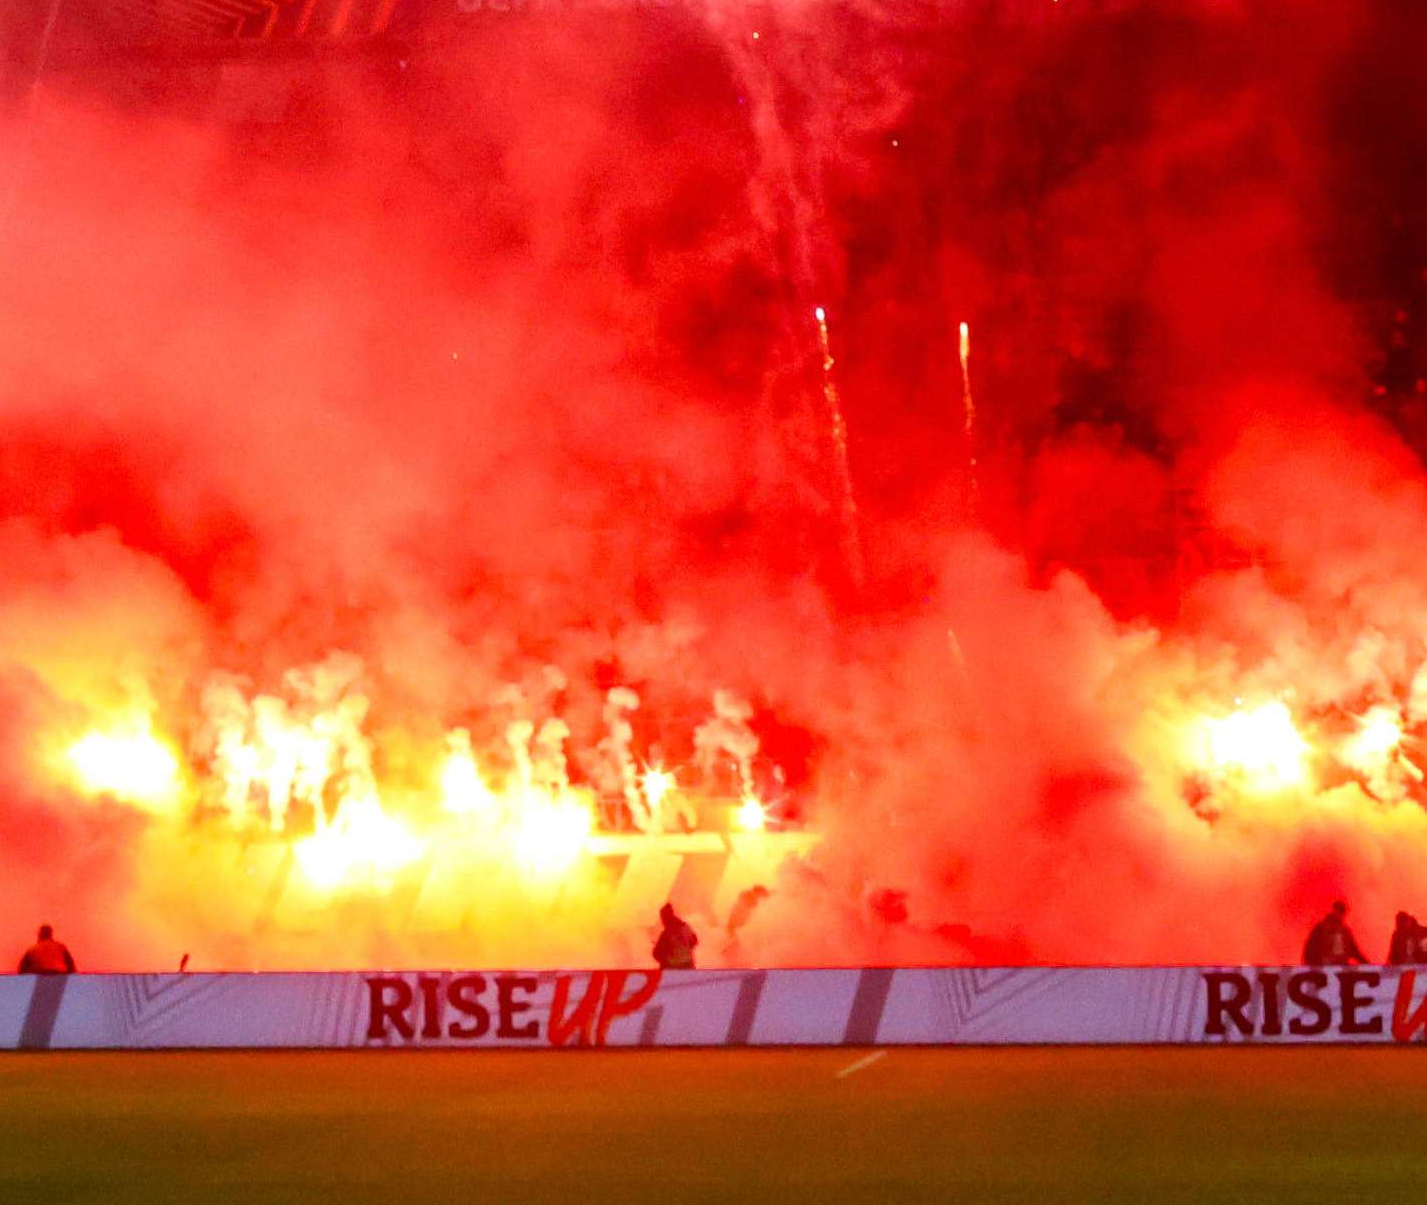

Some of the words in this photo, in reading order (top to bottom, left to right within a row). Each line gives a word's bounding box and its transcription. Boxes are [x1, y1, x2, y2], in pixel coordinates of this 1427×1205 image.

[366, 975, 540, 1040] RISE
[547, 969, 662, 1046] UP
[1202, 970, 1384, 1035] RISE
